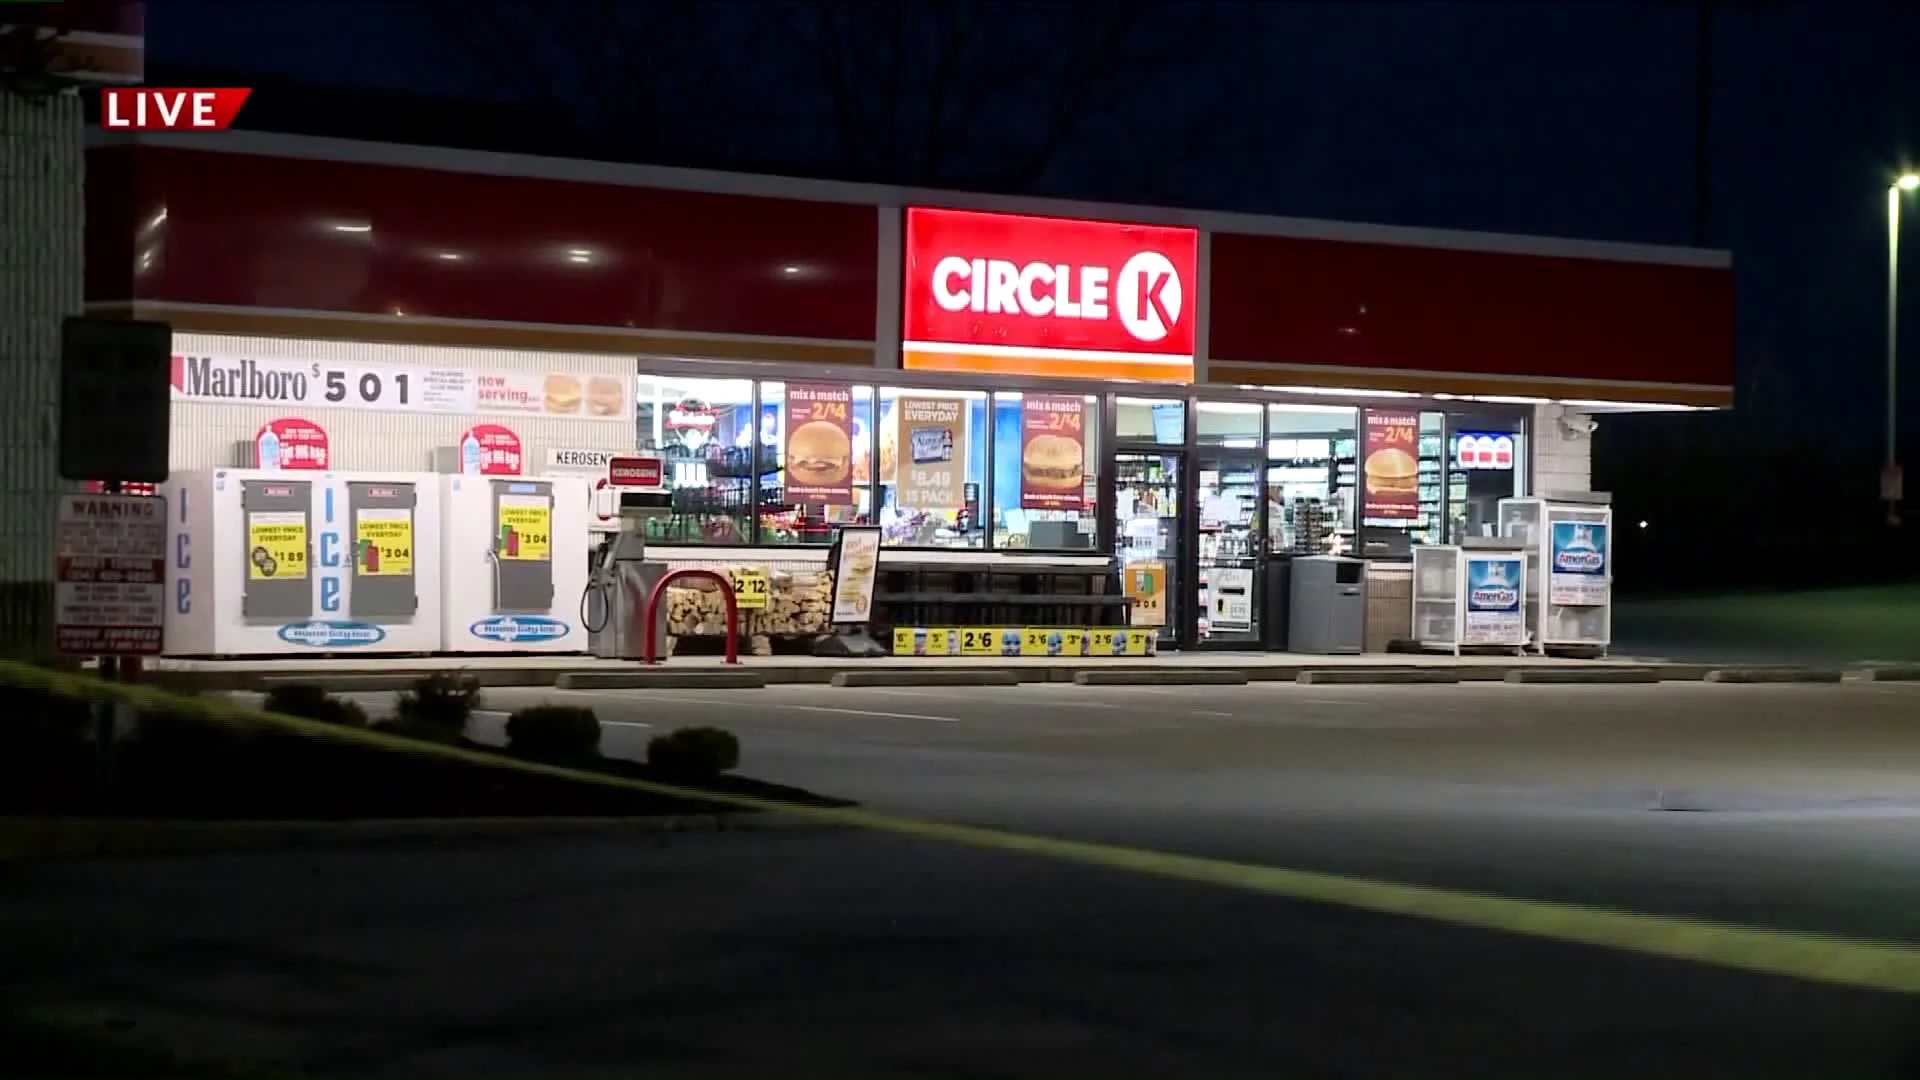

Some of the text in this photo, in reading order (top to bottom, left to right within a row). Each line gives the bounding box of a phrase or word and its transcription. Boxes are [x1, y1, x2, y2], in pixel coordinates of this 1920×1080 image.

[932, 256, 1109, 321] CIRCLE
[186, 356, 307, 401] Marlboro
[478, 376, 505, 387] now
[790, 389, 808, 400] mix
[817, 390, 849, 402] match
[1026, 400, 1045, 410] mix
[1052, 401, 1081, 412] match
[904, 410, 959, 422] EVERYDAY
[1367, 415, 1383, 425] mix
[1390, 416, 1417, 426] match
[556, 451, 614, 466] KEROSEN
[72, 502, 153, 517] WARNING
[1559, 551, 1600, 564] AmeriGas
[1474, 590, 1514, 602] AmeriGas
